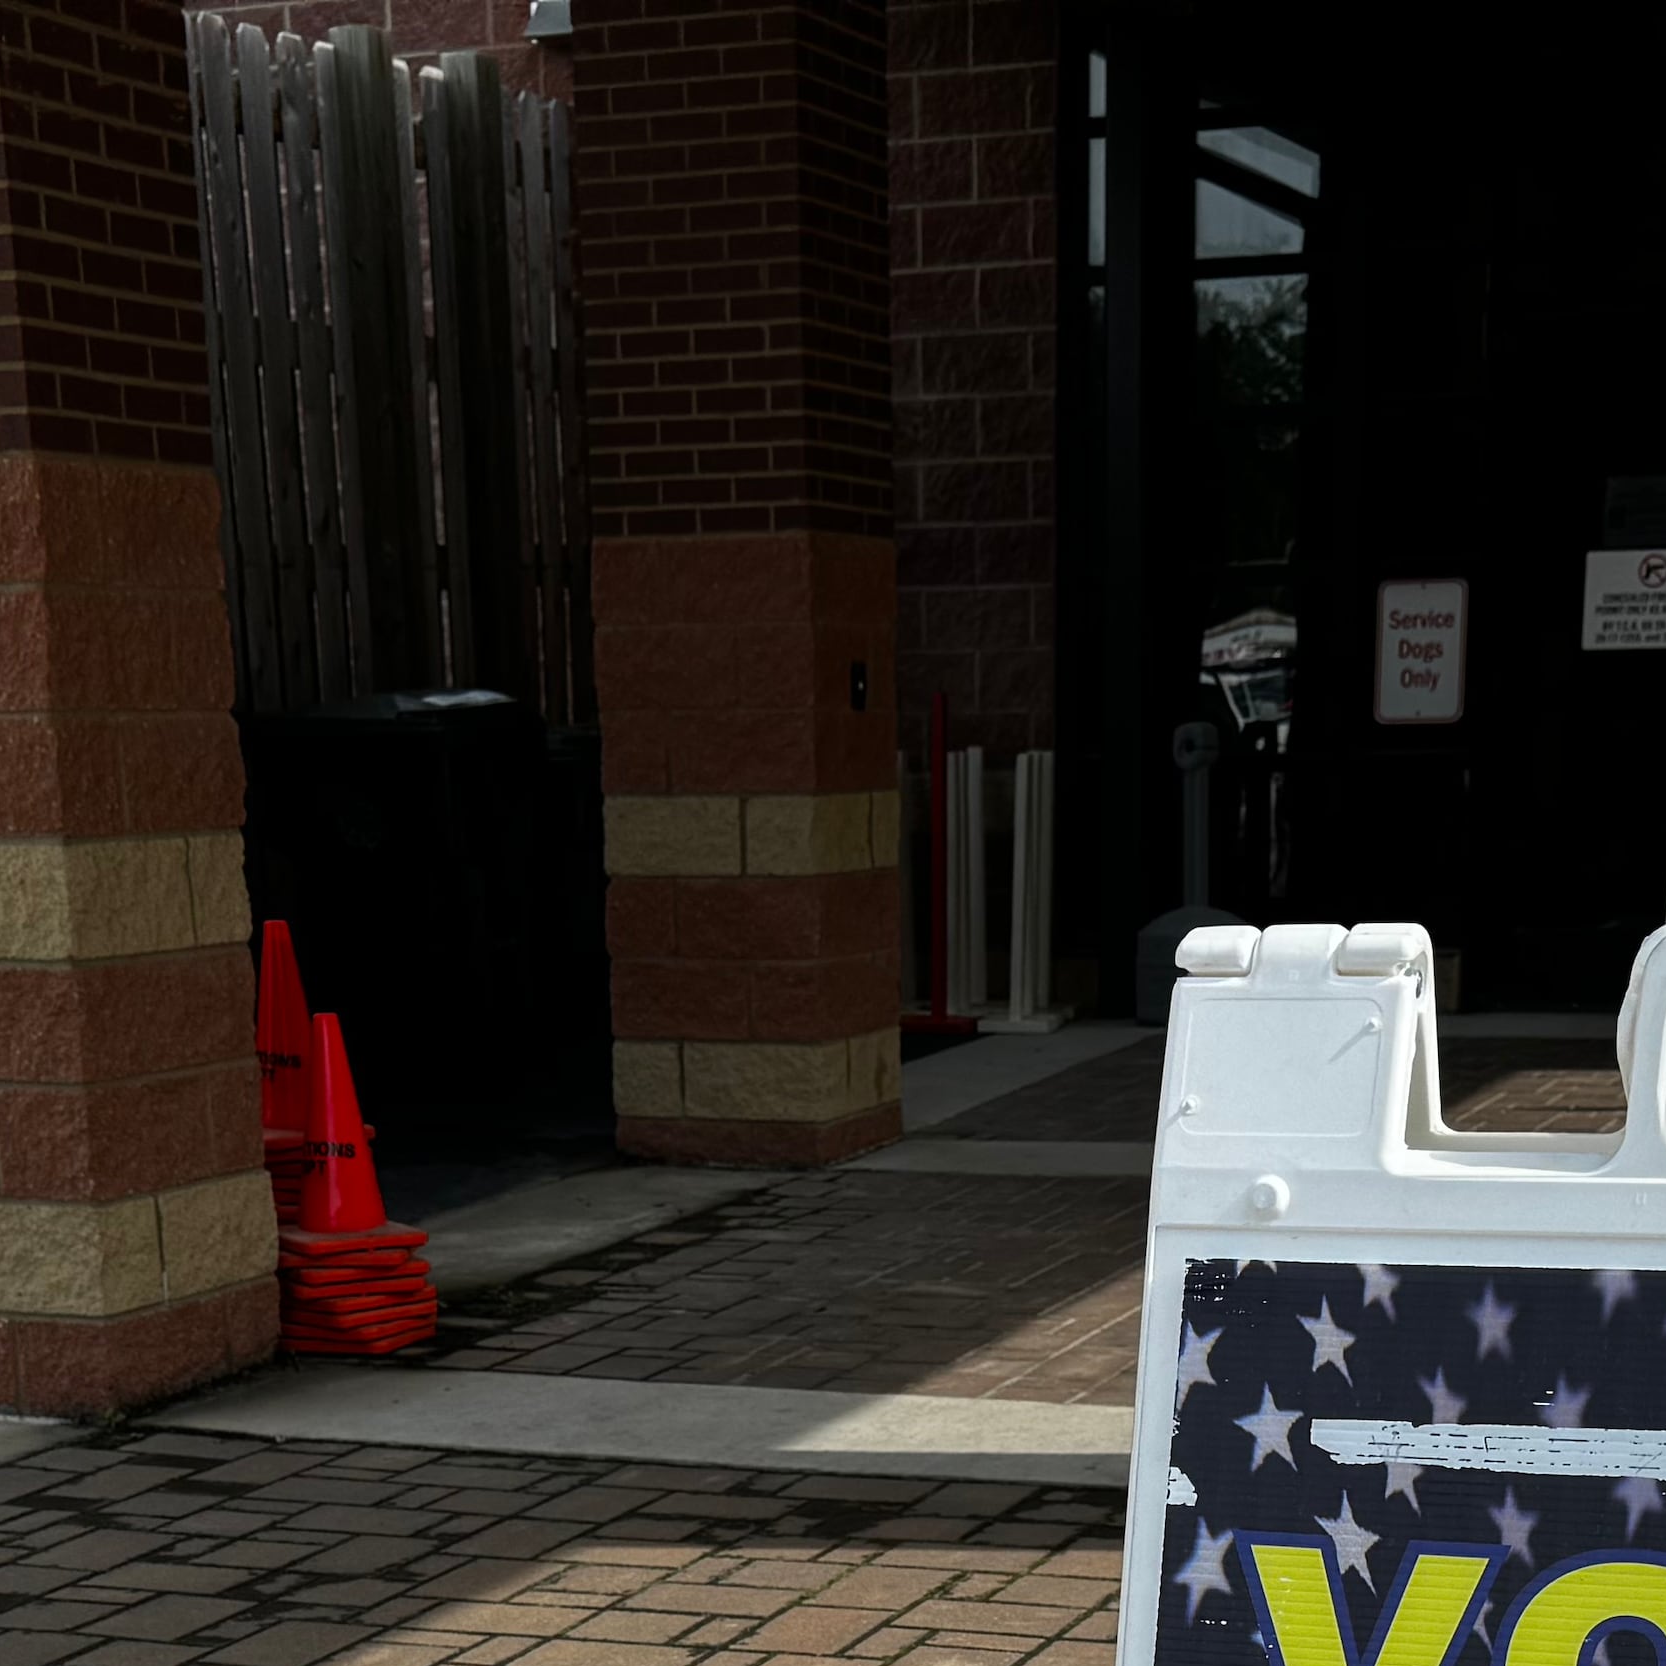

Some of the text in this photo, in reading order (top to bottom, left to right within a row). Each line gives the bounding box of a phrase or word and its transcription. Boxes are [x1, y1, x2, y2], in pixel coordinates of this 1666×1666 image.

[1389, 609, 1455, 630] Service
[1398, 639, 1443, 663] Dogs
[1400, 668, 1440, 692] Only
